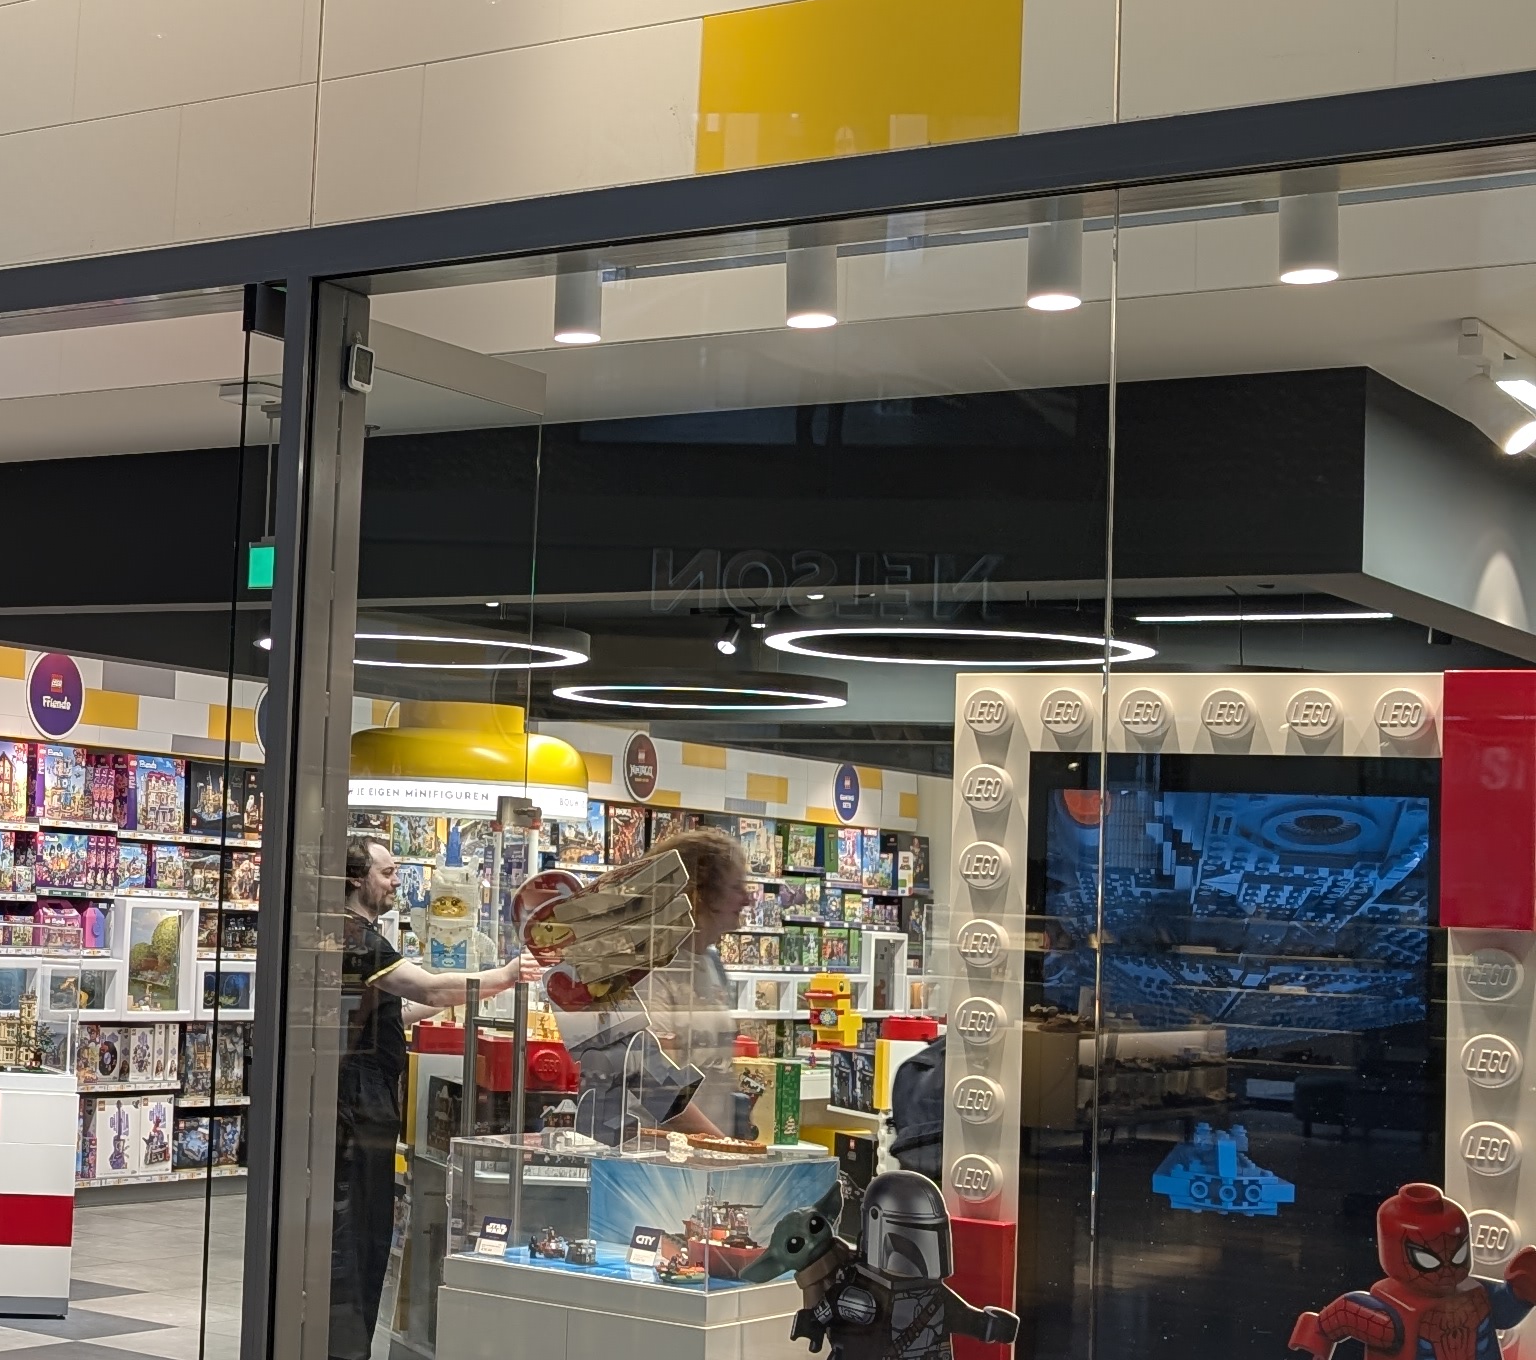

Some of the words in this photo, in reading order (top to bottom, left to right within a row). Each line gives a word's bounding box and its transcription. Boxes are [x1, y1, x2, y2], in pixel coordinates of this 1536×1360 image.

[42, 695, 72, 711] Friends
[968, 700, 1005, 723] LEGO
[1044, 700, 1082, 723] LEGO
[1123, 700, 1162, 724] LEGO
[1205, 701, 1246, 725] LEGO
[1291, 701, 1332, 726] LEGO
[1379, 702, 1422, 727] LEGO
[369, 787, 400, 797] EIGEN
[965, 777, 1002, 800] LEGO
[963, 854, 1000, 878] LEGO
[961, 931, 998, 955] LEGO
[1467, 963, 1512, 986] LEGO
[958, 1009, 996, 1033] LEGO
[1466, 1048, 1512, 1074] LEGO
[956, 1087, 994, 1112] LEGO
[1465, 1135, 1511, 1162] LEGO
[954, 1166, 992, 1191] LEGO
[635, 1234, 656, 1246] CITY
[1472, 1224, 1510, 1251] EGO
